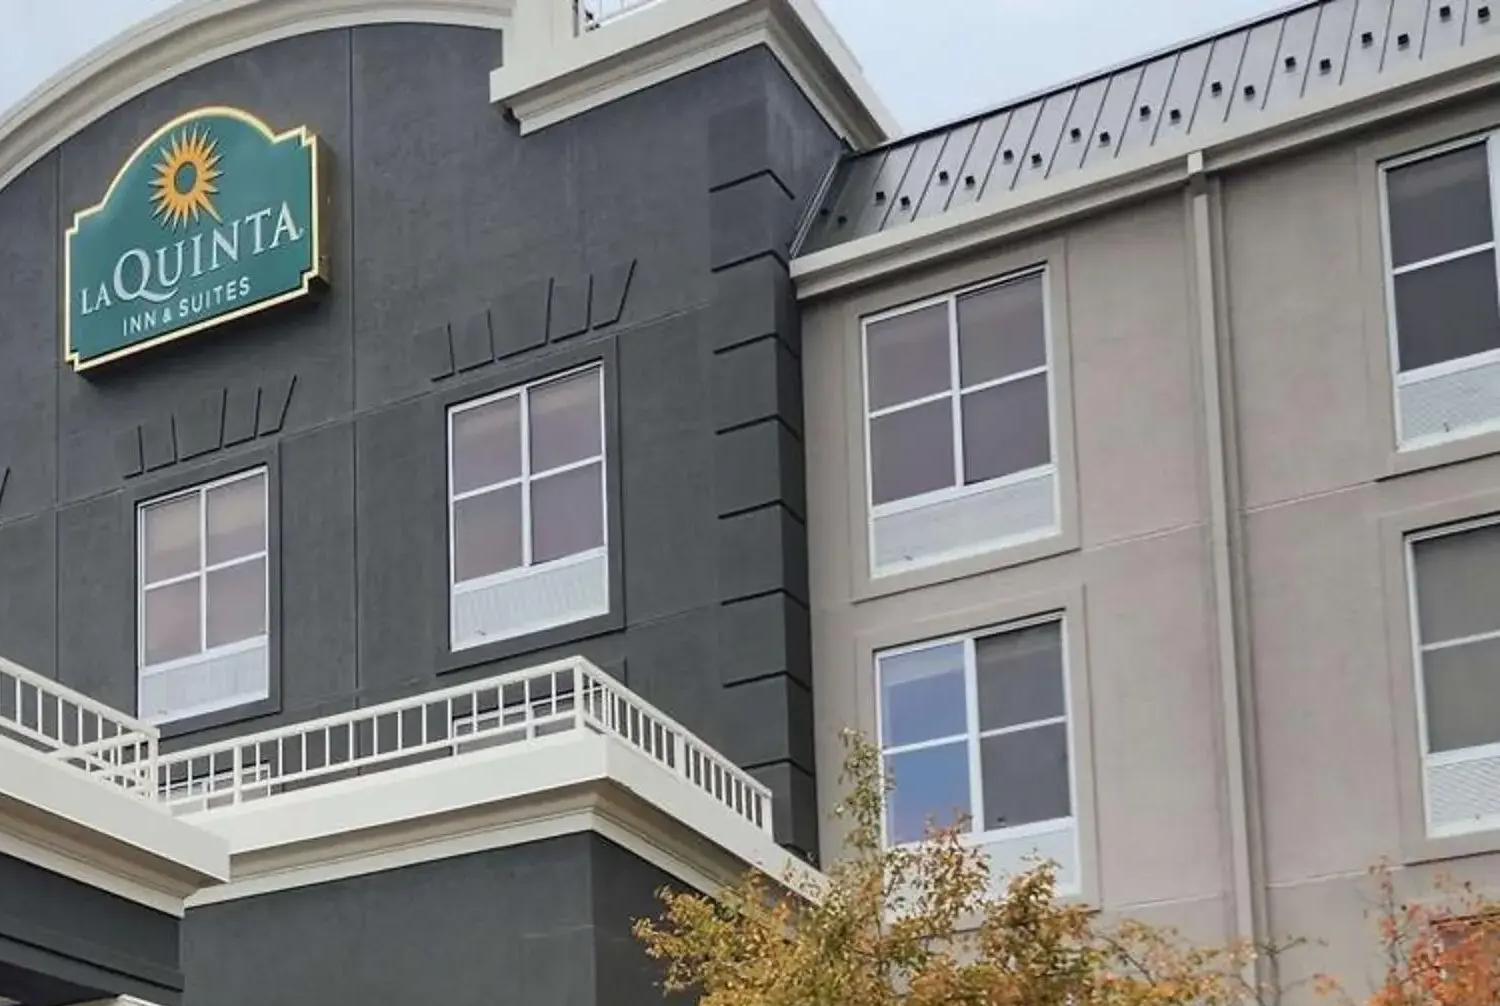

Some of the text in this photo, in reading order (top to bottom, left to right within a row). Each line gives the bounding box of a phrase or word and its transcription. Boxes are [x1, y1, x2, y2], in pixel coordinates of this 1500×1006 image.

[113, 201, 304, 302] QUINTA
[123, 276, 251, 336] INN & SUITES
